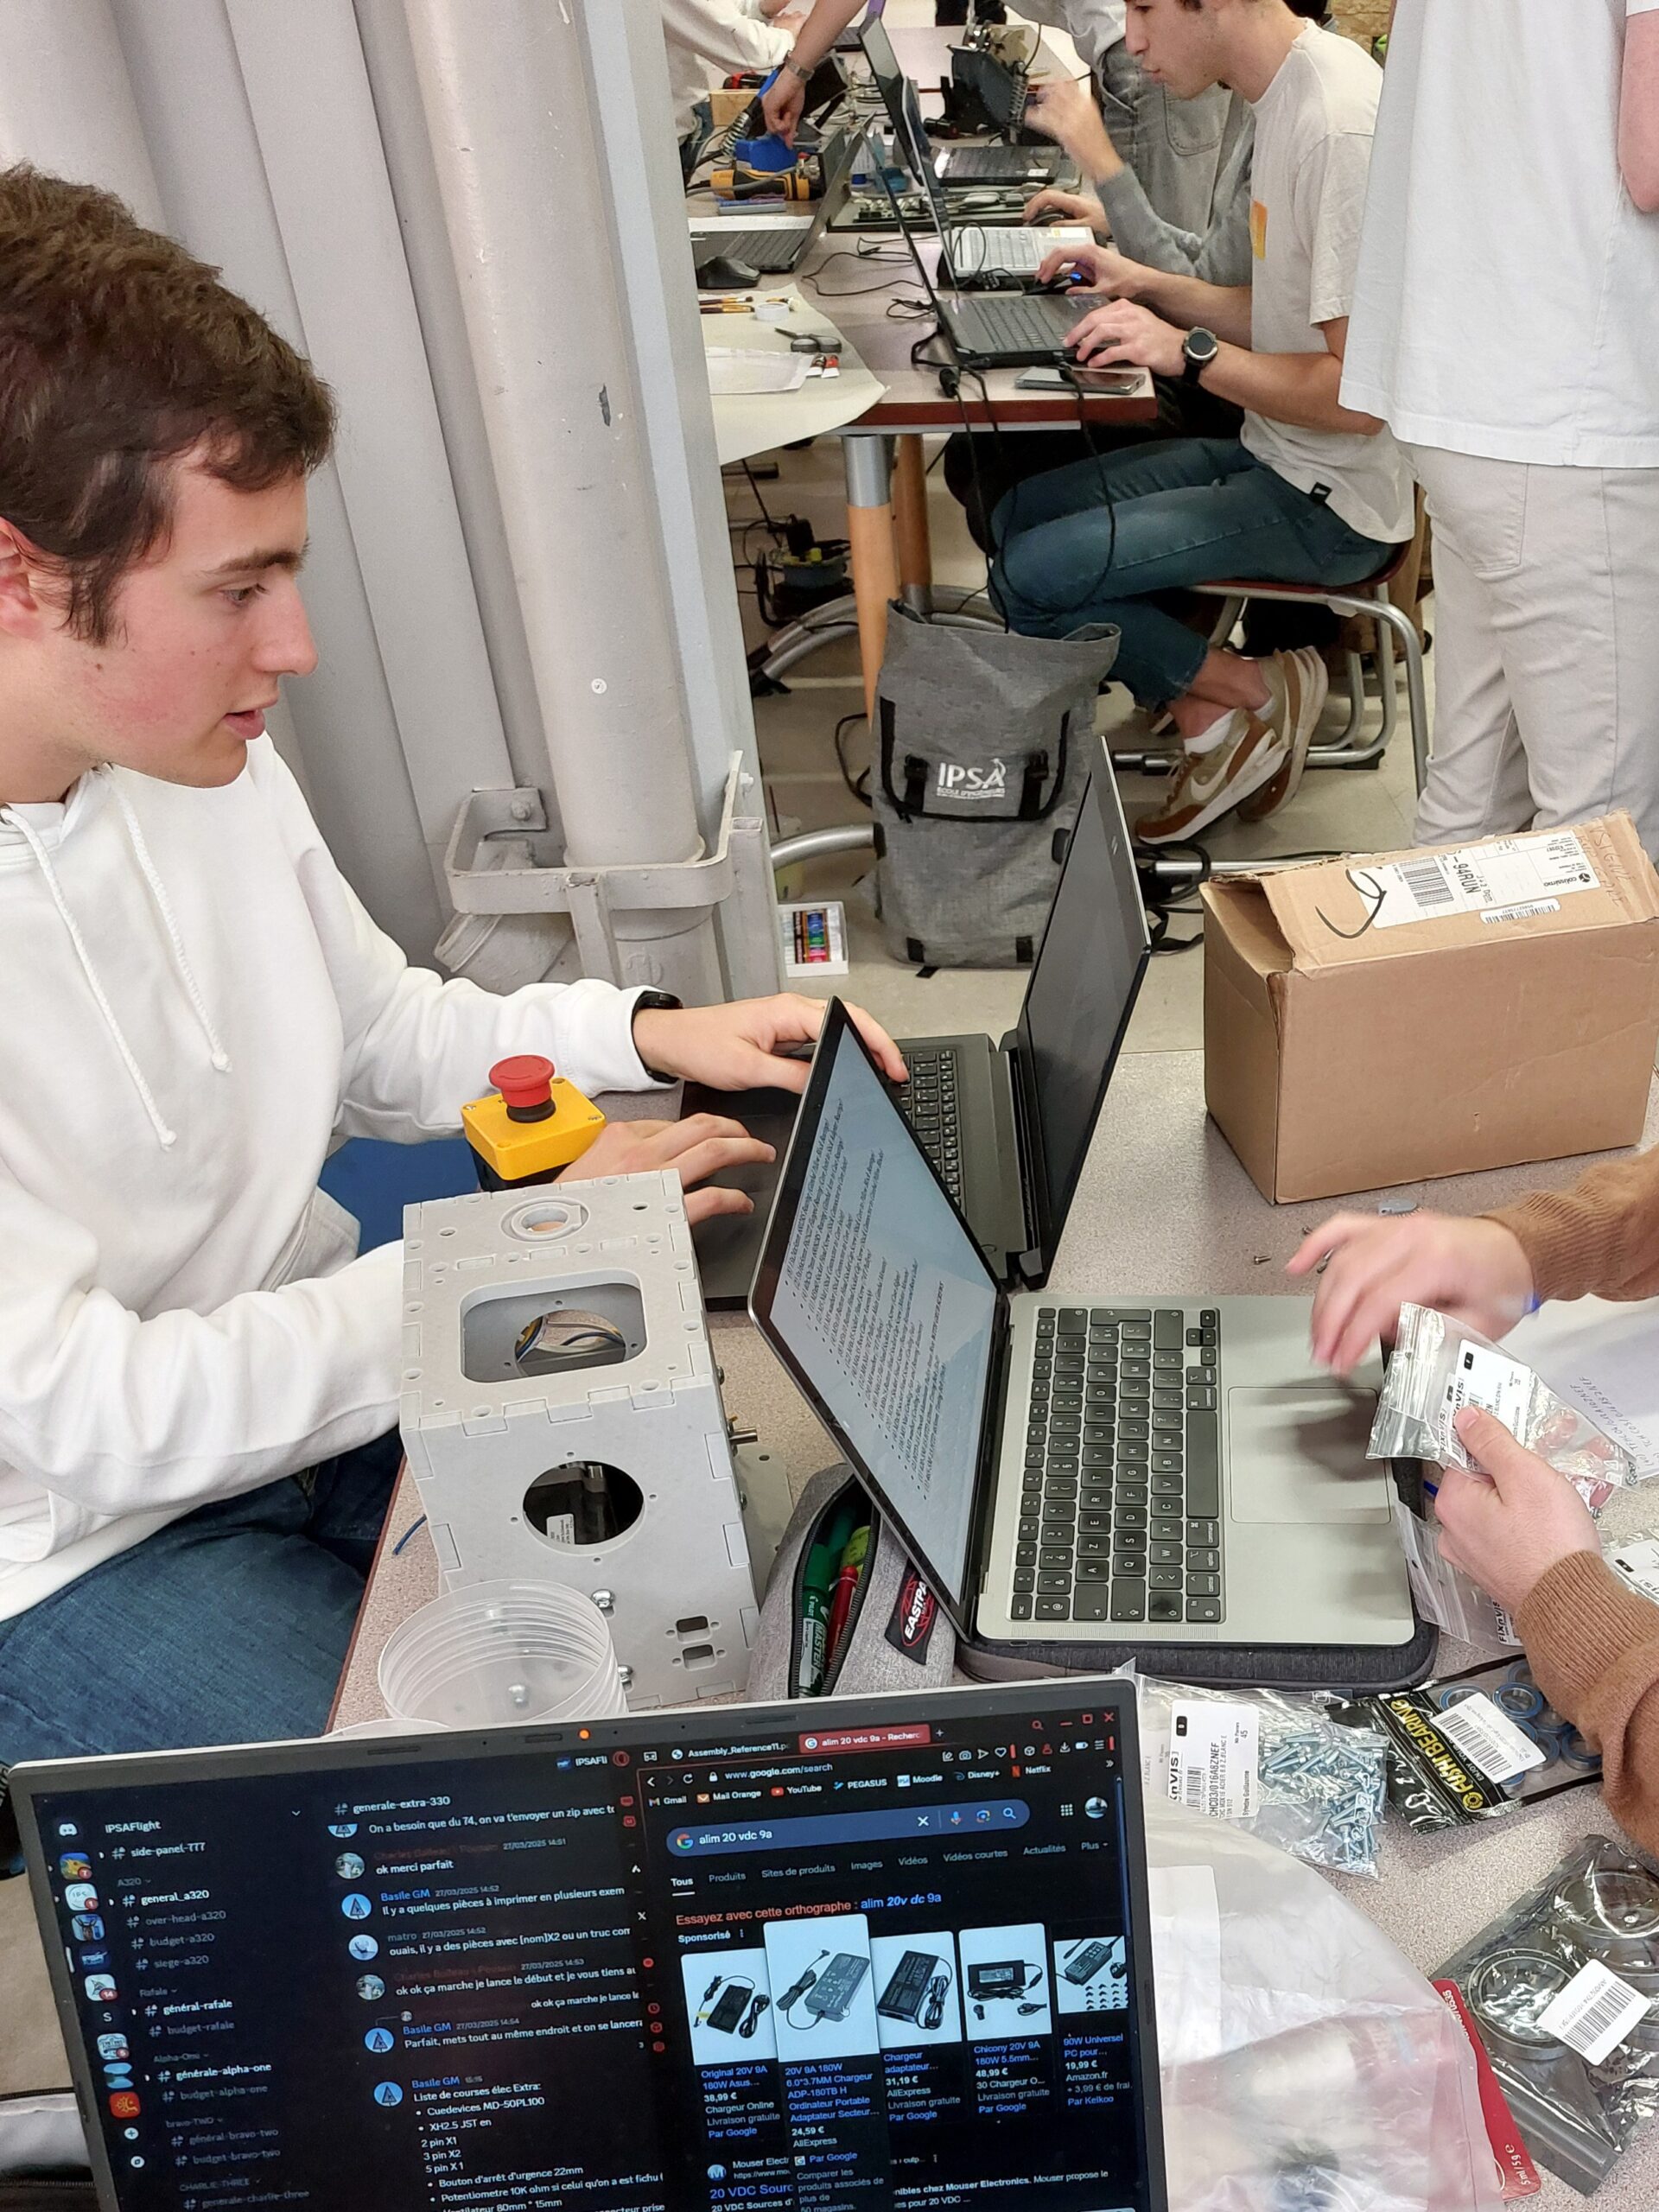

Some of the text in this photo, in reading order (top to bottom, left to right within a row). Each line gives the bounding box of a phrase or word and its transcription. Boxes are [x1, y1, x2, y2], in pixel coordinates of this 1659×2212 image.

[938, 759, 1006, 789] IPSA
[1543, 876, 1577, 887] colissimo
[904, 1580, 927, 1639] EASTPA
[1240, 1730, 1249, 1738] 45
[1391, 1699, 1445, 1758] BEARING
[724, 1763, 832, 1779] www.google.com/search
[1465, 1763, 1484, 1781] ENJOY
[847, 1778, 887, 1789] PEGASUS
[912, 1774, 943, 1783] Moodle
[786, 1784, 822, 1794] YouTube
[663, 1796, 687, 1804] Gmail
[712, 1791, 730, 1800] Mail
[353, 1796, 450, 1814] generale-extra-330
[368, 1824, 384, 1833] On
[392, 1820, 426, 1831] besoin
[427, 1820, 446, 1830] que
[448, 1816, 461, 1827] du
[461, 1815, 477, 1825] 74,
[505, 1811, 550, 1821] t'envoyer
[566, 1807, 581, 1818] zip
[582, 1807, 605, 1815] avec
[105, 1820, 161, 1833] IPSAFlight
[699, 1829, 772, 1844] alim 20 vdc 9a
[130, 1841, 205, 1857] side-panel-777
[376, 1859, 454, 1874] ok merci parfait
[760, 1869, 784, 1878] Sites
[798, 1863, 835, 1876] produits
[850, 1860, 883, 1870] Images
[670, 1878, 693, 1886] Tous
[708, 1872, 746, 1882] Produits
[140, 1889, 209, 1905] general_a320
[382, 1905, 389, 1915] Il
[390, 1907, 396, 1916] y
[406, 1902, 450, 1914] quelques
[452, 1899, 484, 1910] pièces
[486, 1897, 492, 1906] à
[493, 1894, 537, 1906] imprimer
[553, 1889, 597, 1902] plusieurs
[676, 1913, 723, 1925] Essayez
[725, 1910, 753, 1920] avec
[754, 1907, 782, 1917] cette
[784, 1901, 851, 1915] orthographe
[860, 1897, 884, 1909] alim
[886, 1895, 908, 1907] 20v
[909, 1893, 925, 1904] dc
[926, 1892, 941, 1903] 9a
[404, 2037, 441, 2048] Parfait,
[442, 2035, 467, 2044] mets
[467, 2033, 489, 2042] tout
[504, 2029, 534, 2038] même
[535, 2024, 570, 2036] endroit
[571, 2024, 582, 2032] et
[883, 2052, 922, 2062] Chargeur
[1065, 2060, 1089, 2070] 19,99
[975, 2068, 1000, 2077] 48,99
[1065, 2070, 1108, 2081] Amazon.fr
[411, 2075, 460, 2088] Basile GM
[886, 2075, 918, 2086] 31,19 €
[413, 2083, 540, 2101] Liste de courses élec Extra:
[703, 2091, 737, 2102] 38,99 €
[704, 2101, 774, 2113] Chargeur Online
[725, 2126, 757, 2136] Google
[791, 2126, 816, 2136] 24,59
[421, 2136, 456, 2148] 2 pin X1
[423, 2149, 461, 2161] 3 pin X2
[438, 2166, 583, 2187] Bouton d'arrêt d'urgence 22mm
